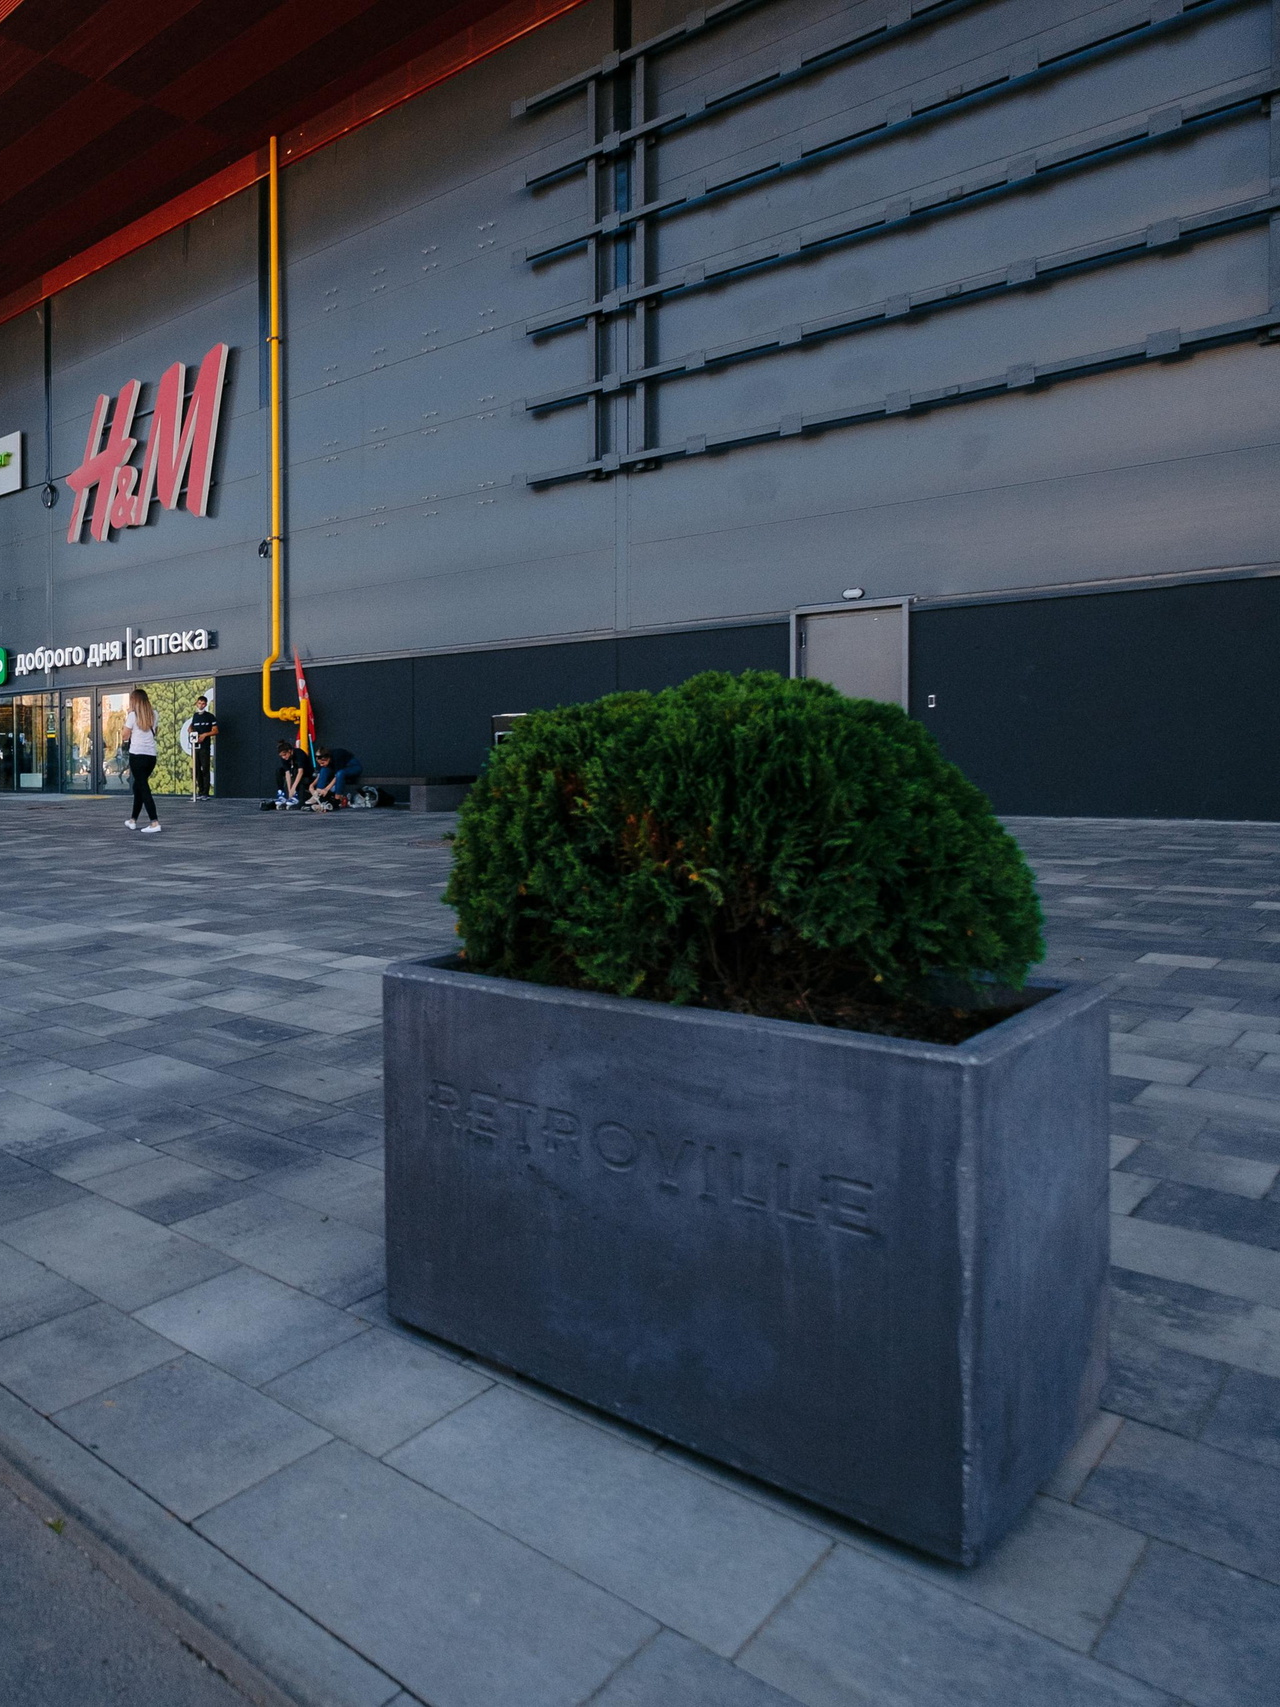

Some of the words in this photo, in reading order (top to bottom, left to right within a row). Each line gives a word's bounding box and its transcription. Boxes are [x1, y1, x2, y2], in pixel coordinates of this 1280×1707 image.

[66, 342, 228, 544] H&M
[15, 645, 86, 677] доброго
[86, 639, 123, 668] дня
[134, 628, 209, 658] аптека
[428, 1079, 880, 1239] RETROVILLE
